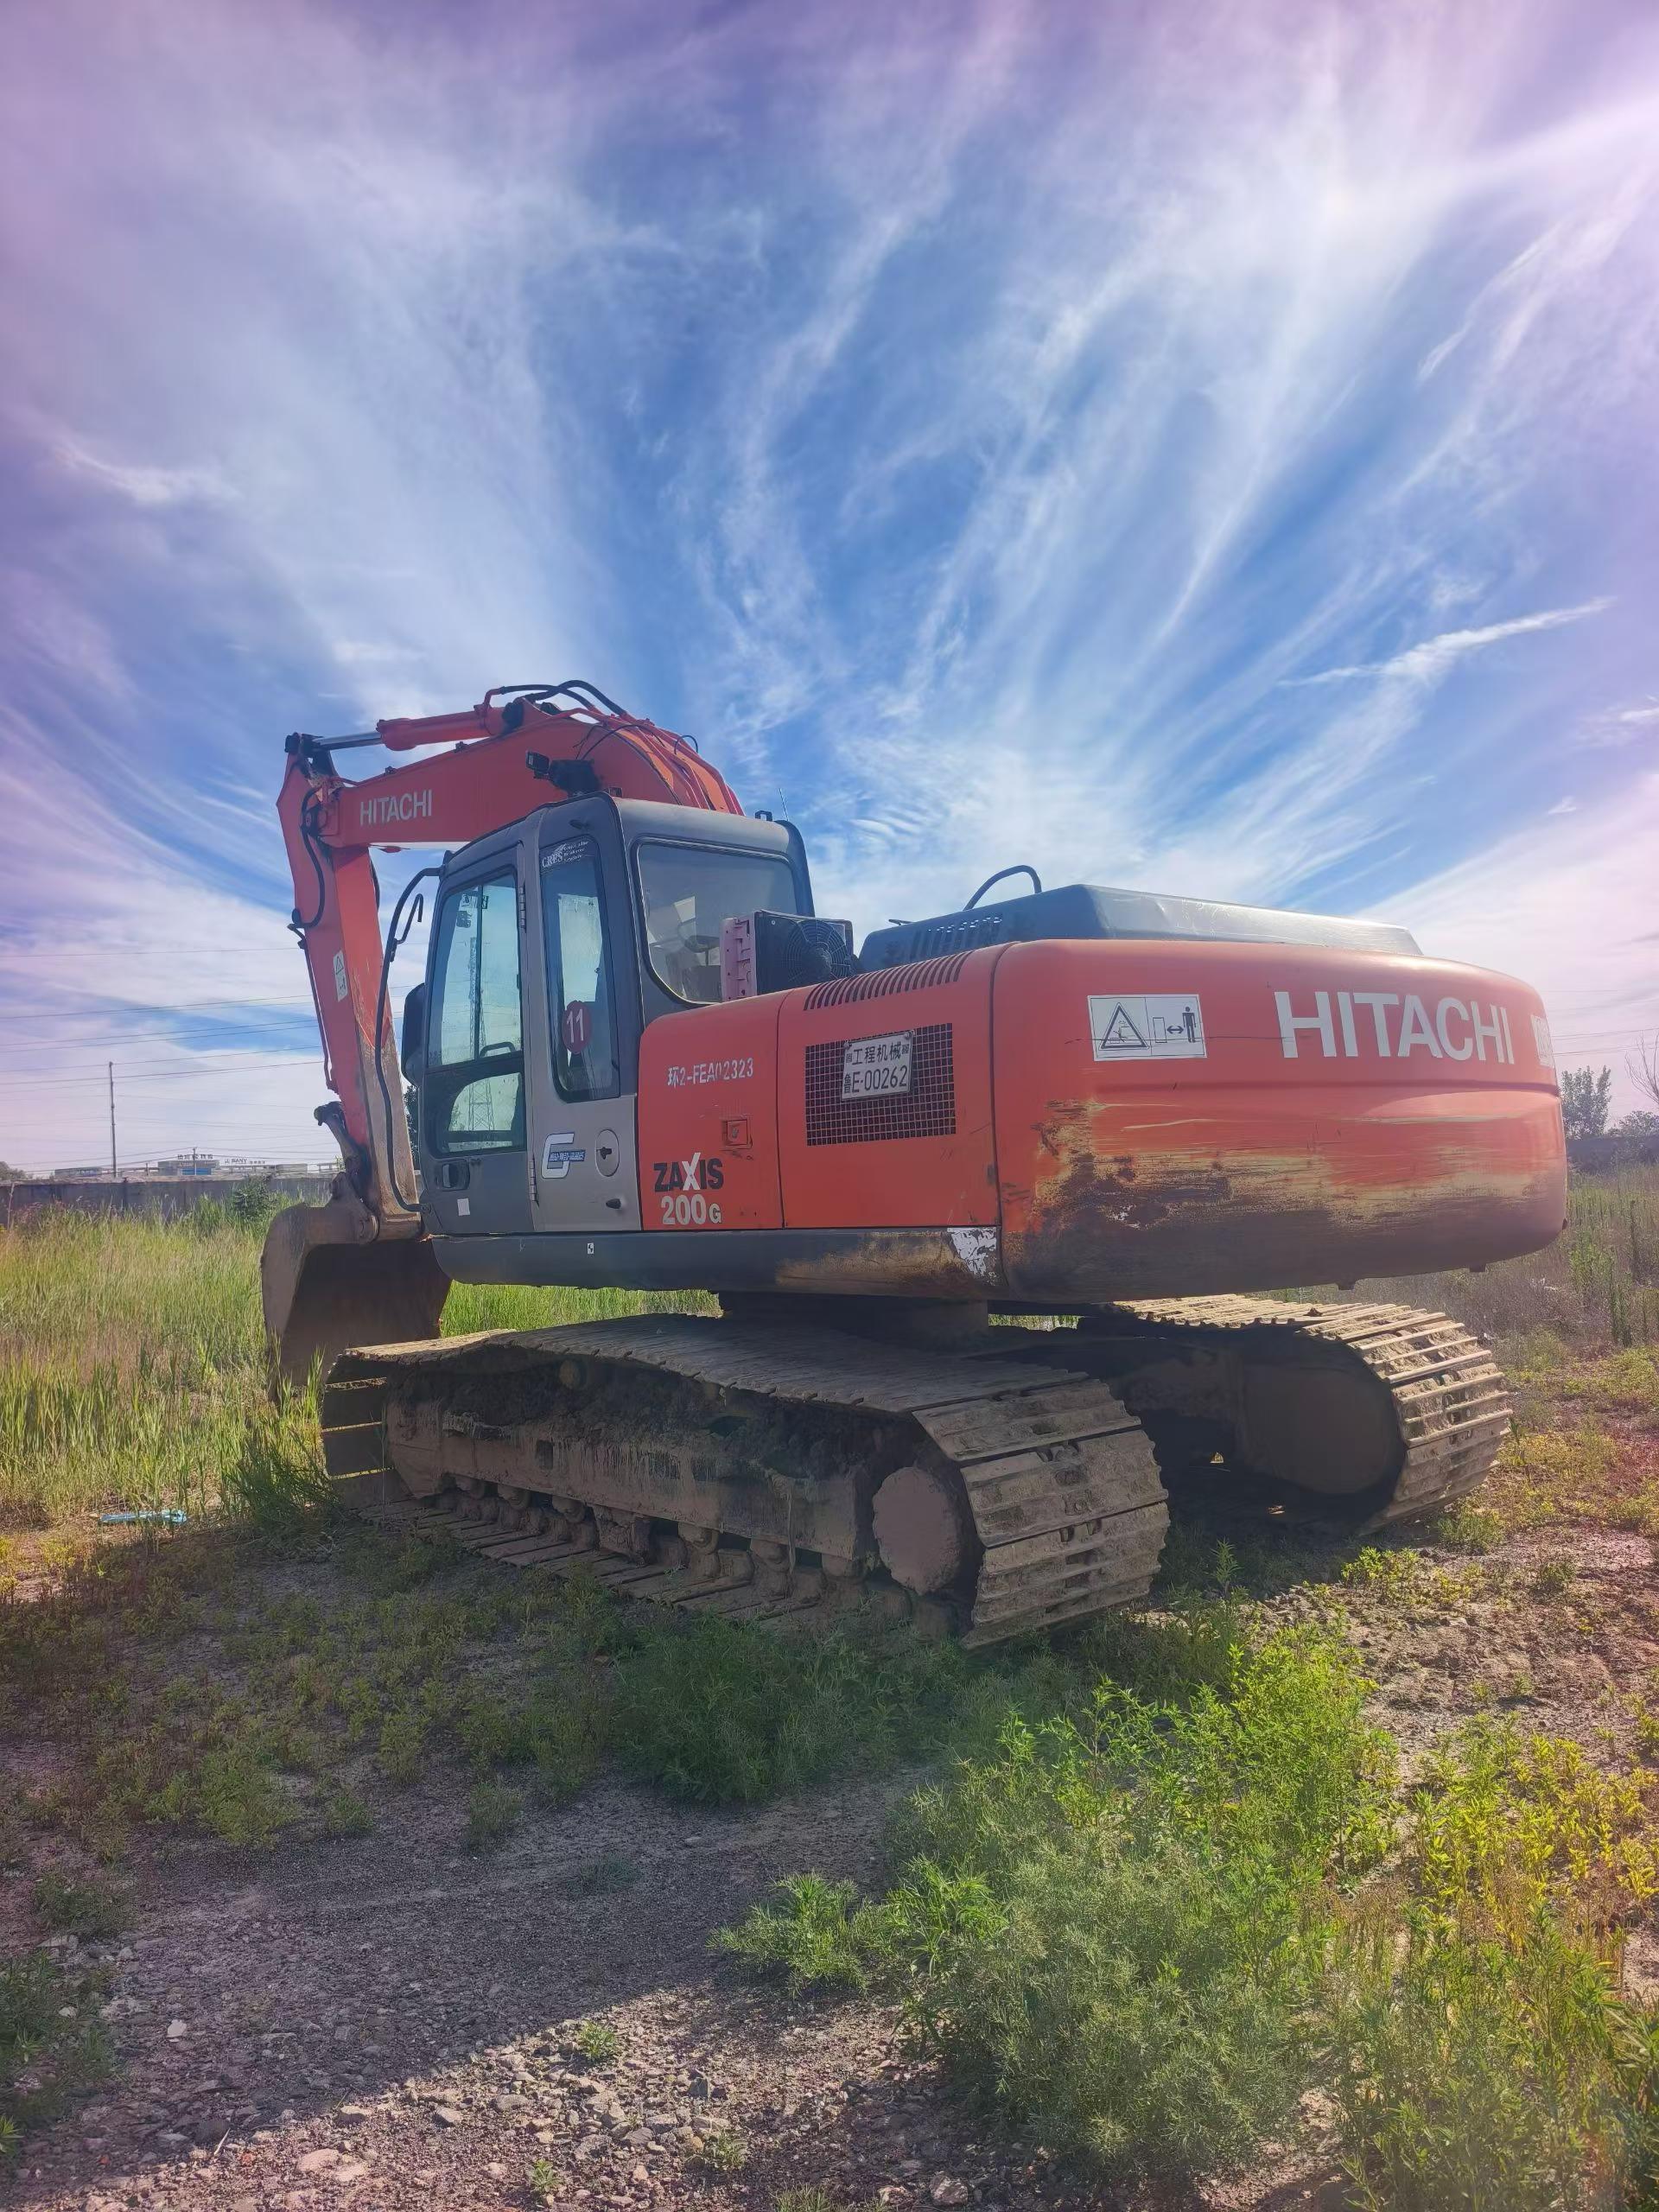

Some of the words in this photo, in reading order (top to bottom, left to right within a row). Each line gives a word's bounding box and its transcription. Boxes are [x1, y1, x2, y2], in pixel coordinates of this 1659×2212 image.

[359, 789, 433, 827] HITACHI
[566, 1008, 584, 1044] 11
[1274, 991, 1515, 1065] HITACHI
[852, 1041, 901, 1065] 工程机械
[653, 1152, 724, 1192] ZAXIS
